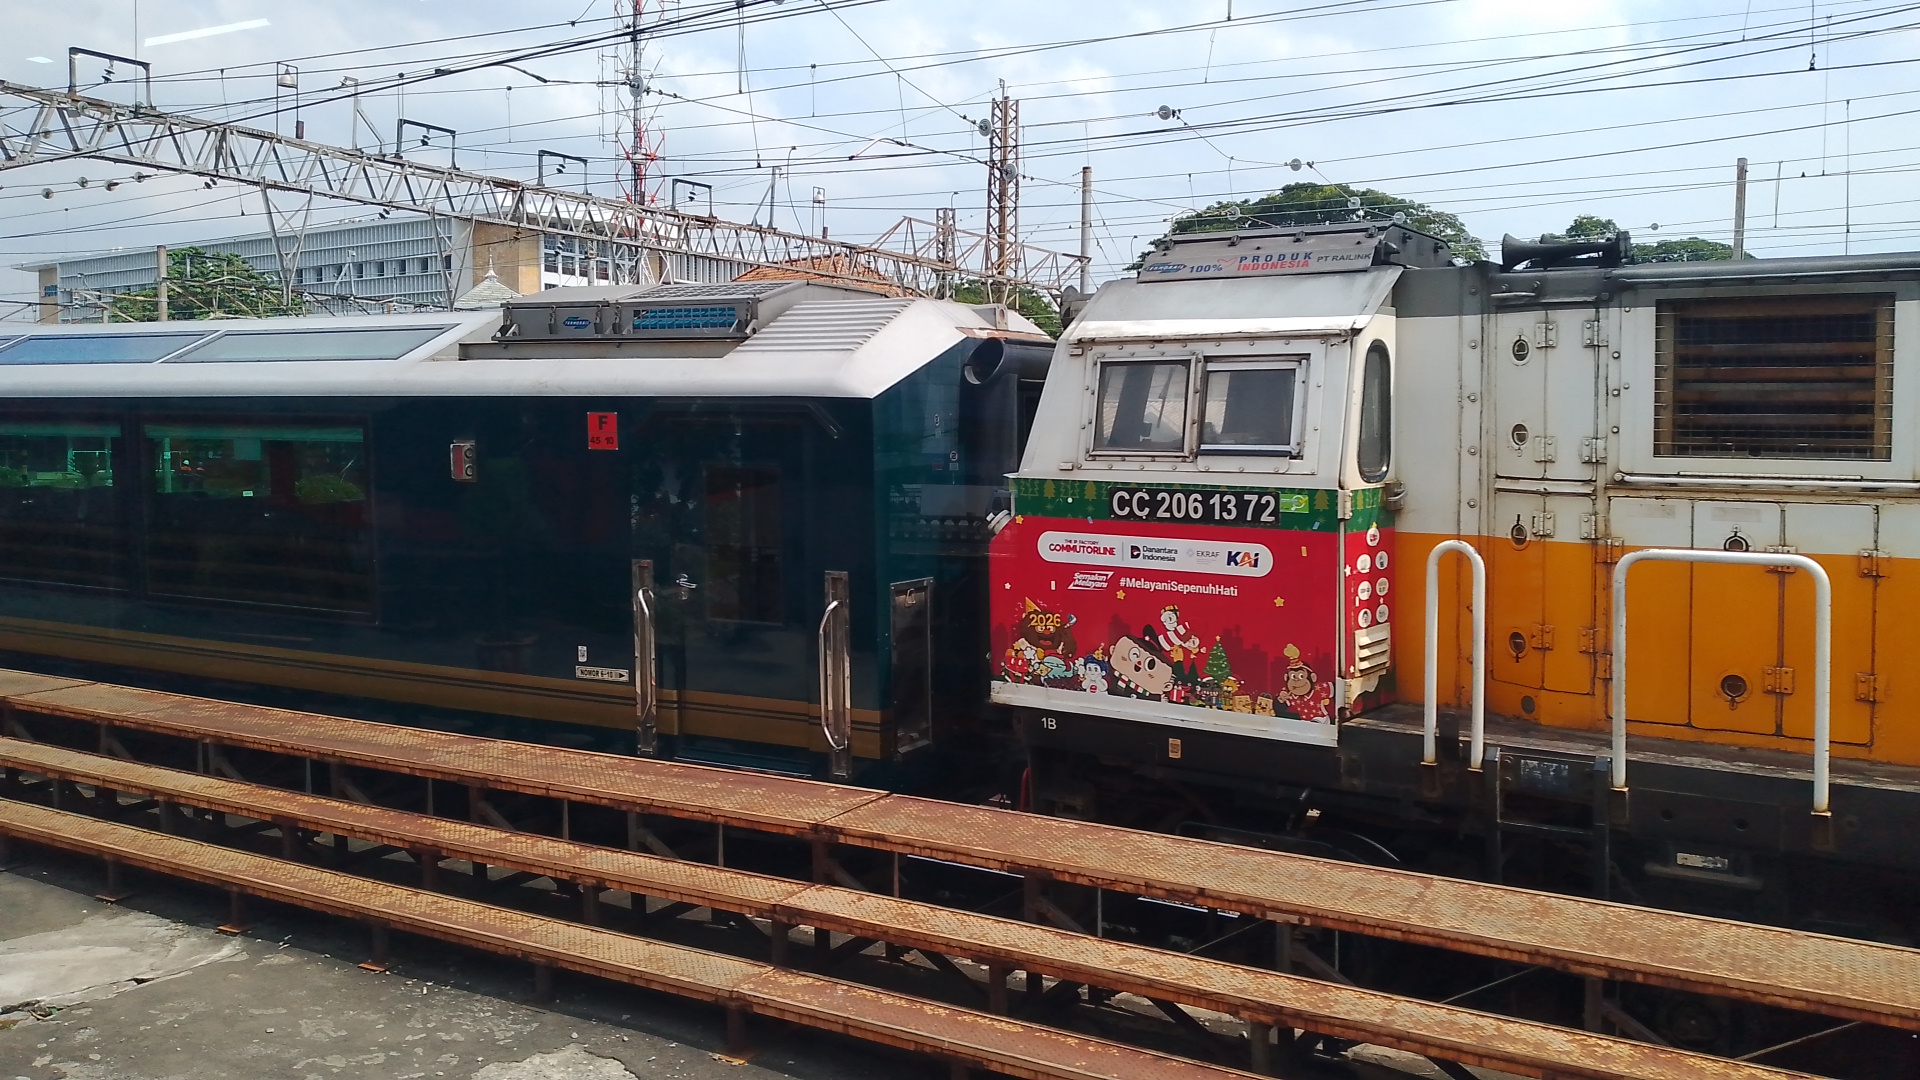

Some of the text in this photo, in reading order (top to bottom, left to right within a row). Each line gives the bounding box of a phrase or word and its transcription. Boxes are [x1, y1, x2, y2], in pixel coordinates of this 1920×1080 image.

[1239, 251, 1313, 264] PRODUK
[1331, 253, 1371, 262] RAILINK
[1190, 264, 1223, 273] 100%
[1237, 260, 1310, 271] INDONESIA
[598, 415, 608, 431] F
[589, 436, 614, 445] 45 10
[1112, 490, 1277, 523] CC 206 13 72
[1048, 543, 1116, 556] COMMUTORLINE
[1142, 545, 1178, 555] Danantara
[1196, 550, 1220, 558] EKRAF
[1142, 553, 1176, 562] Indonesia
[1073, 572, 1107, 581] Semakin
[1074, 579, 1109, 589] Melayani
[1119, 577, 1238, 597] #MelayaniSepenuhHati
[1029, 613, 1061, 627] 2026
[580, 669, 600, 677] NOMOR
[1041, 717, 1057, 730] 1B
